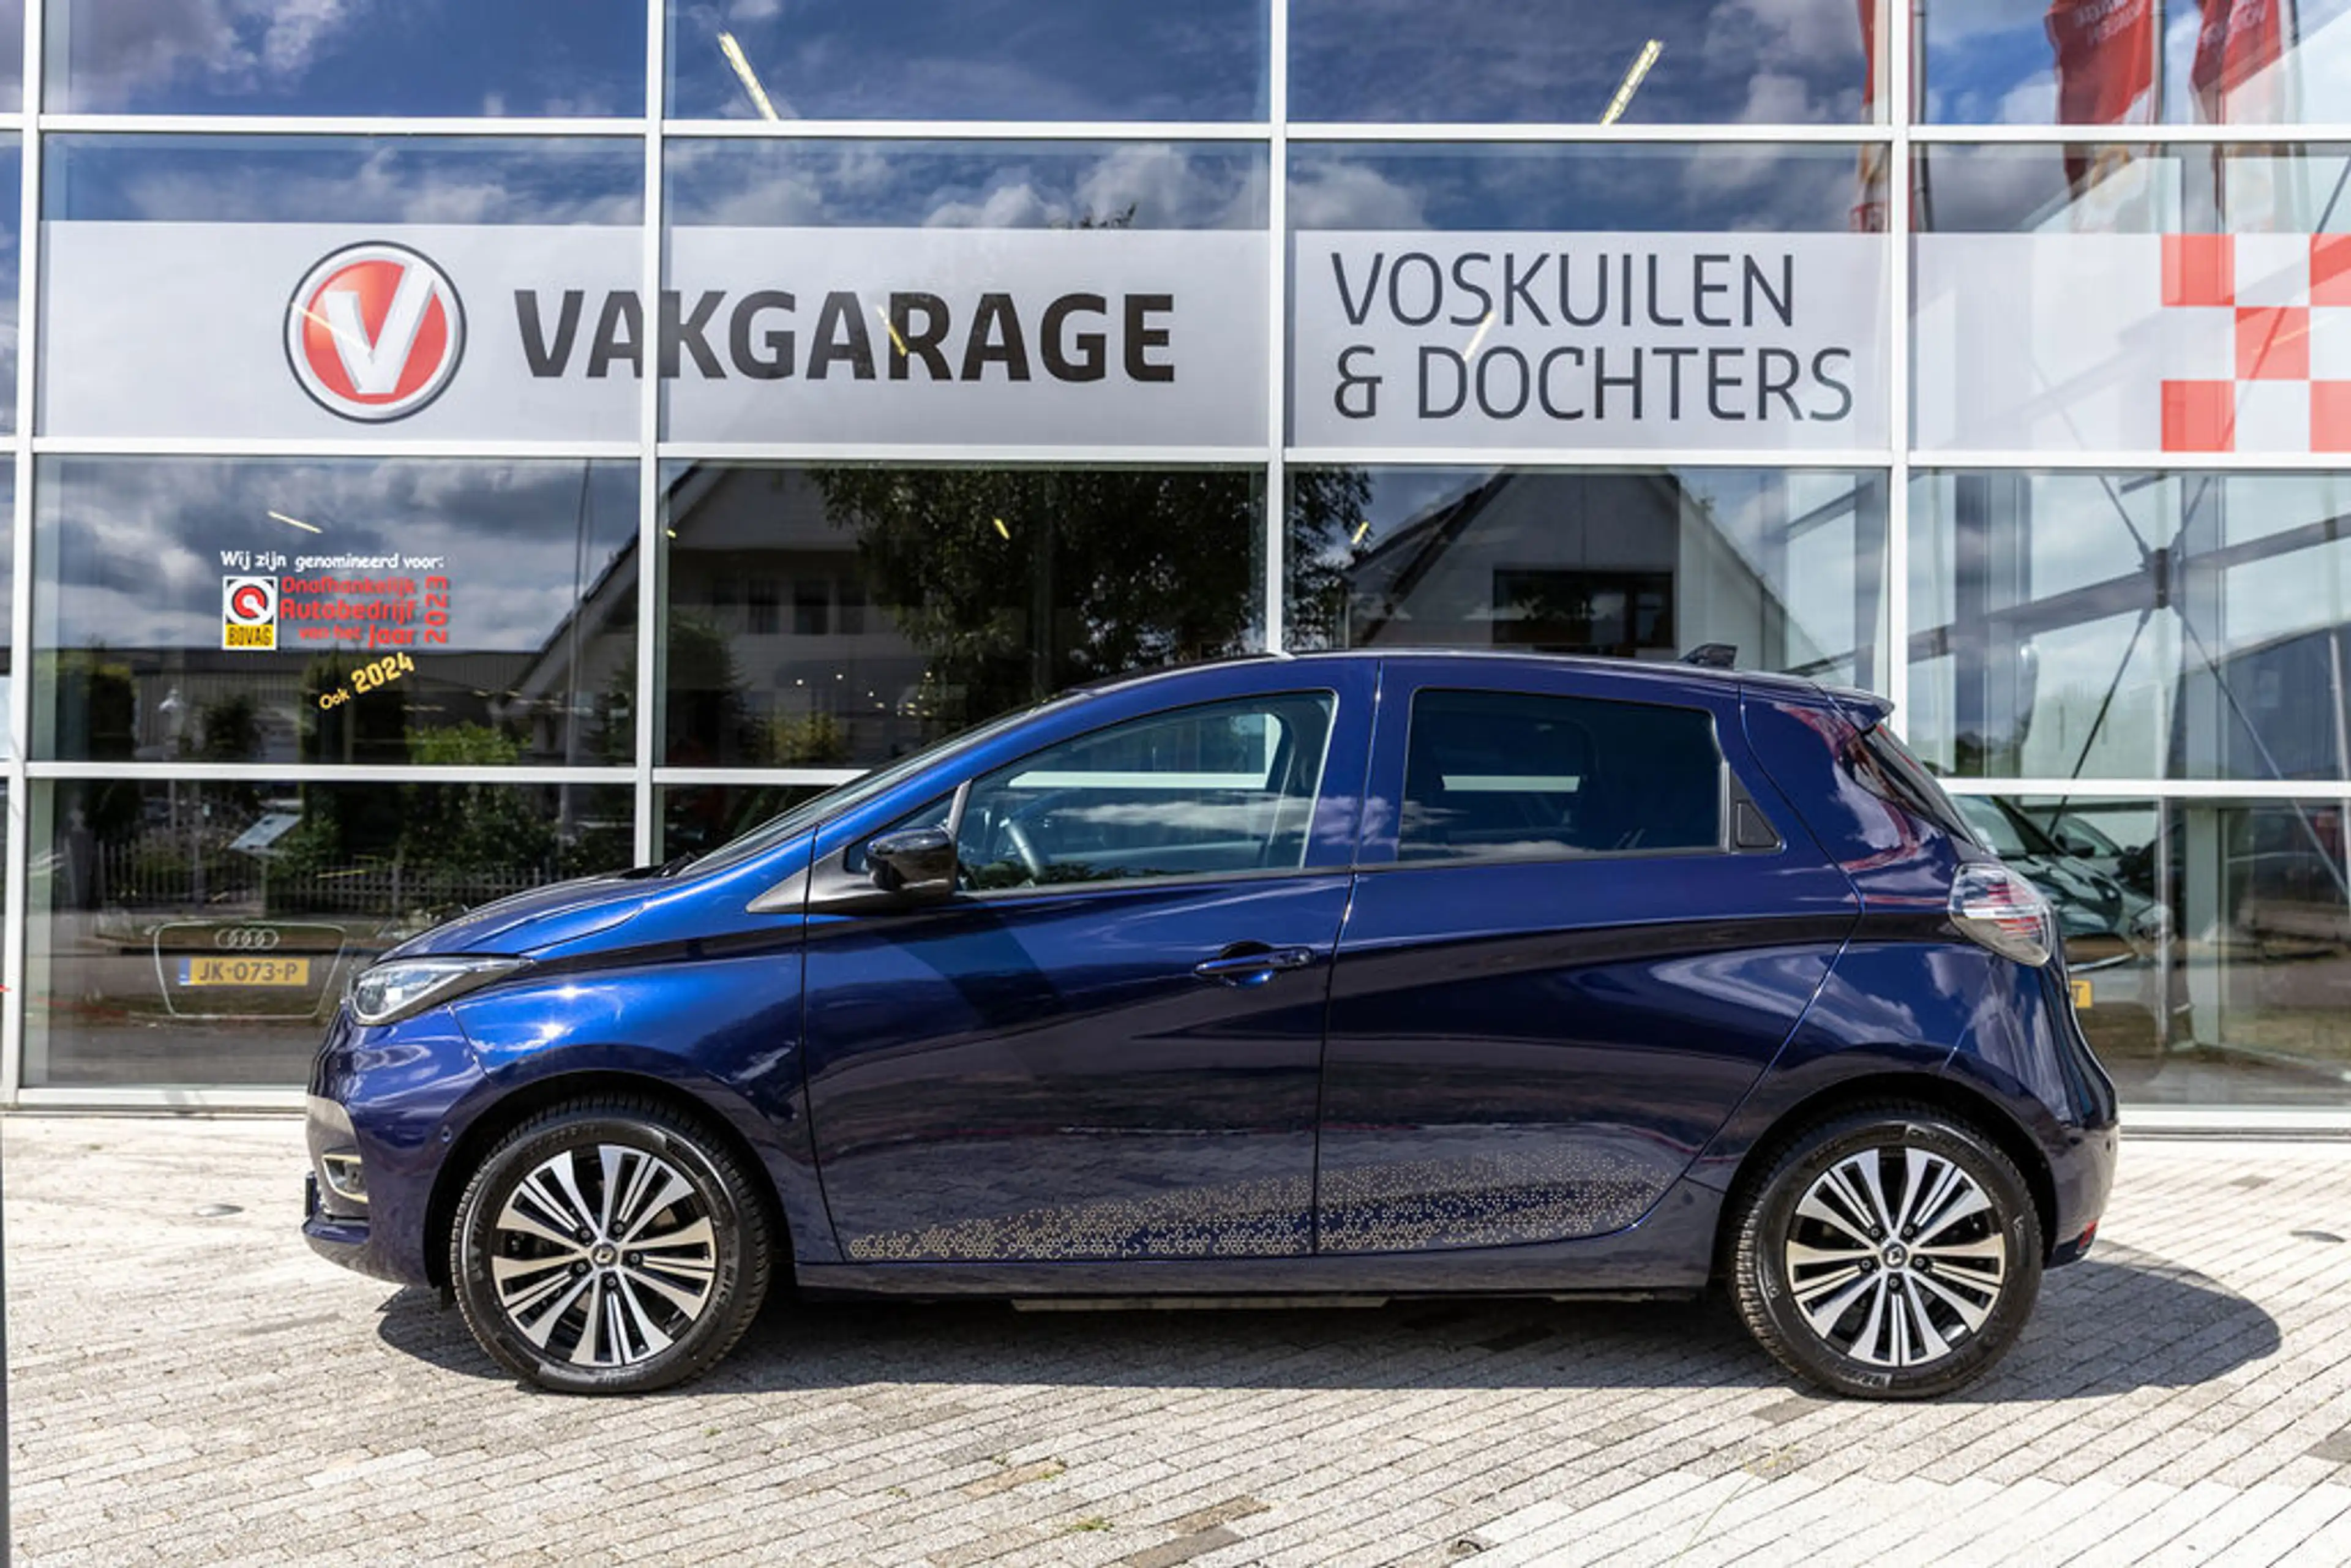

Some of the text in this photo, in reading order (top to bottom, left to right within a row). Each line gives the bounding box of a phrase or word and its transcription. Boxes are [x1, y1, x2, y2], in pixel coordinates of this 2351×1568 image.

[1331, 252, 1794, 328] VOSKUILEN
[323, 261, 437, 394] V
[514, 289, 1175, 383] VAKGARAGE
[1333, 345, 1853, 421] & DOCHTERS
[221, 550, 444, 572] Wij zijn genomineerd voor:
[280, 598, 417, 625] Autobedrijf
[424, 576, 449, 644] 2023
[319, 651, 415, 710] Ook 2024
[199, 961, 298, 980] JK-073-P
